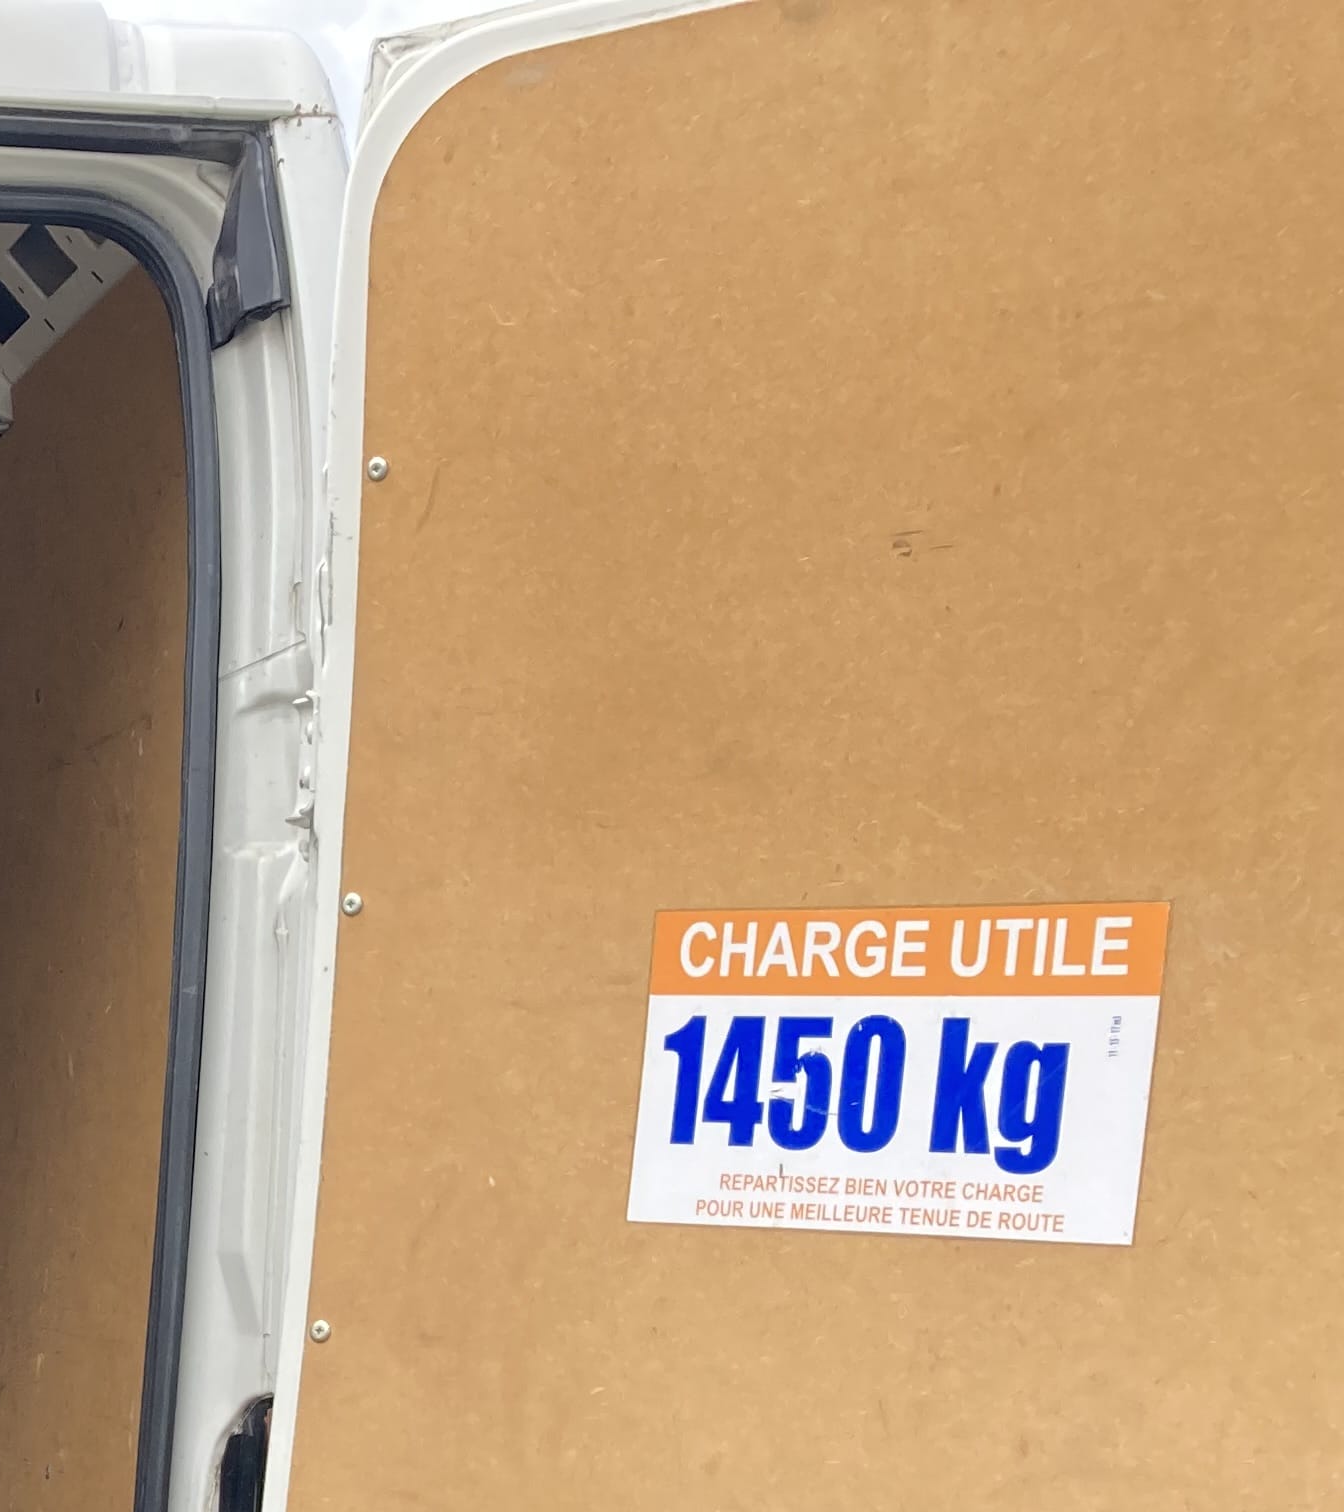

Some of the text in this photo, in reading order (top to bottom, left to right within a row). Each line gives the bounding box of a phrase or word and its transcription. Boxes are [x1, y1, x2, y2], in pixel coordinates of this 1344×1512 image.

[679, 916, 1132, 978] CHARGE UTILE
[664, 1014, 1071, 1174] 1450 kg
[719, 1173, 1044, 1203] REPARTISSEZ BIEN VOTRE CHARGE
[696, 1199, 1065, 1233] POUR UNE MEILLEURE TENUE DE ROUTE
